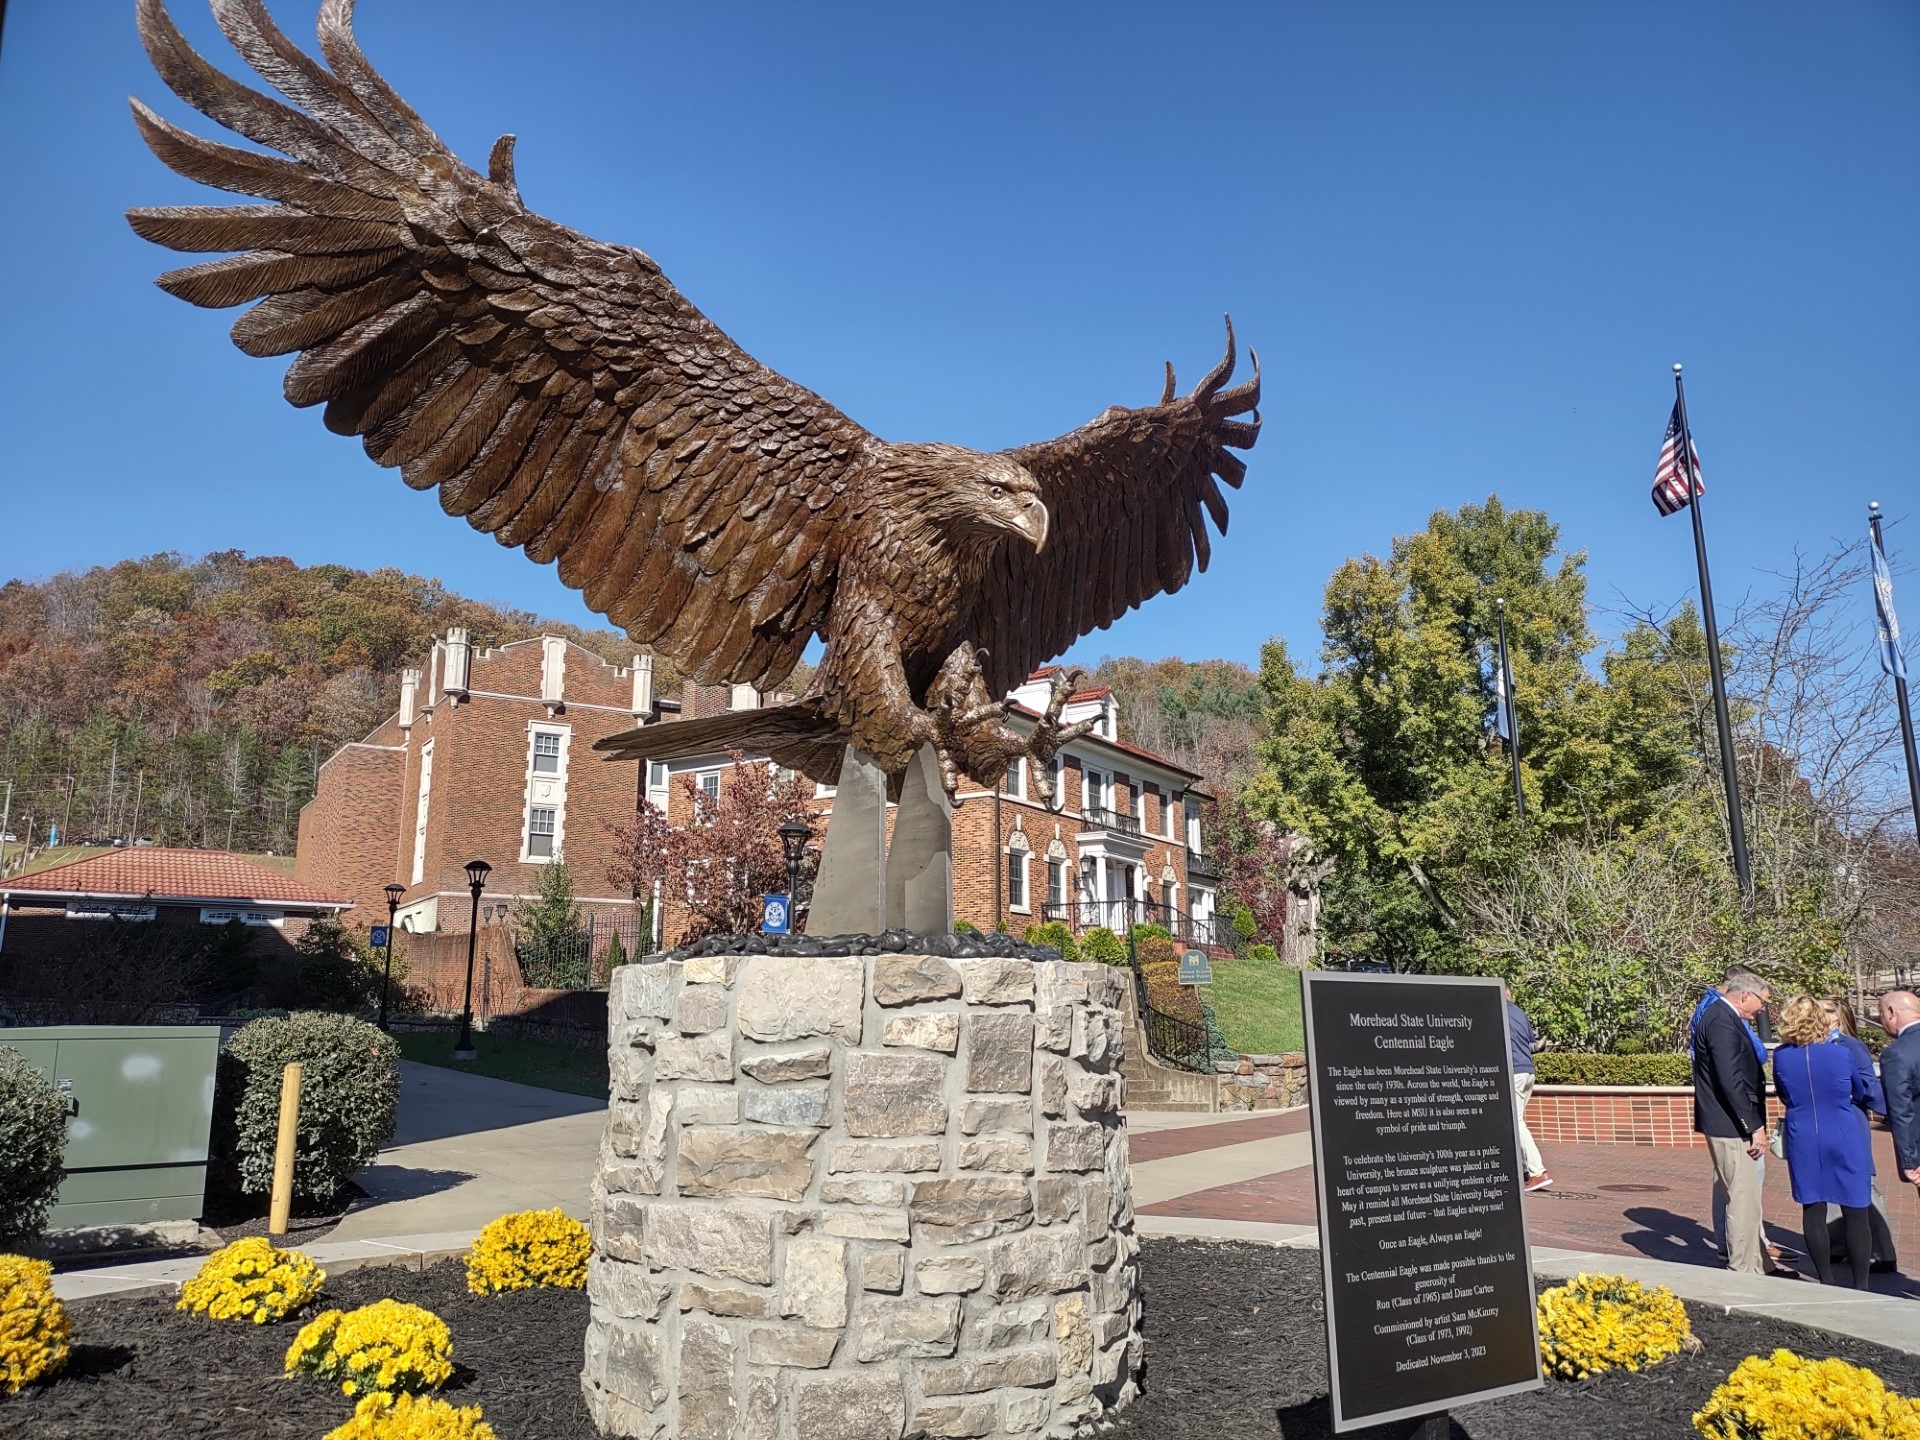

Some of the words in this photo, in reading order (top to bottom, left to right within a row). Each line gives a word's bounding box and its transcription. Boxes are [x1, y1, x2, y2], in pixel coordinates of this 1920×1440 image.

[1350, 1013, 1398, 1027] Morehead
[1401, 1014, 1424, 1027] State
[1426, 1015, 1472, 1030] University
[1375, 1036, 1426, 1049] Centennial
[1429, 1037, 1454, 1052] Eagle
[1328, 1067, 1341, 1077] The
[1343, 1067, 1362, 1078] Eagle
[1364, 1067, 1375, 1076] has
[1376, 1066, 1392, 1075] been
[1394, 1066, 1424, 1075] Morehead
[1426, 1066, 1441, 1075] State
[1479, 1065, 1499, 1073] mascot
[1336, 1082, 1353, 1090] since
[1355, 1081, 1365, 1090] the
[1367, 1081, 1383, 1092] early
[1407, 1080, 1428, 1089] Across
[1430, 1080, 1440, 1088] the
[1461, 1079, 1471, 1087] the
[1472, 1079, 1488, 1088] Eagle
[1489, 1078, 1495, 1086] is
[1334, 1097, 1357, 1106] viewed
[1359, 1096, 1368, 1107] by
[1370, 1097, 1388, 1107] many
[1404, 1094, 1427, 1105] symbol
[1428, 1094, 1435, 1103] of
[1464, 1092, 1487, 1102] courage
[1489, 1091, 1498, 1100] and
[1355, 1110, 1385, 1120] freedom.
[1387, 1109, 1402, 1118] Here
[1404, 1110, 1410, 1118] at
[1412, 1108, 1427, 1118] MSU
[1429, 1108, 1434, 1117] it
[1436, 1107, 1441, 1116] is
[1442, 1107, 1454, 1116] also
[1456, 1107, 1469, 1115] seen
[1376, 1123, 1400, 1135] symbol
[1402, 1123, 1409, 1133] of
[1411, 1122, 1426, 1134] pride
[1428, 1122, 1439, 1131] and
[1343, 1155, 1352, 1165] To
[1354, 1154, 1383, 1164] celebrate
[1385, 1153, 1395, 1163] the
[1455, 1150, 1468, 1159] year
[1469, 1149, 1475, 1157] as
[1483, 1146, 1500, 1158] public
[1347, 1169, 1383, 1181] University,
[1384, 1168, 1395, 1177] the
[1396, 1167, 1418, 1176] bronze
[1419, 1165, 1448, 1176] sculpture
[1450, 1164, 1461, 1172] was
[1463, 1162, 1482, 1172] placed
[1483, 1161, 1489, 1170] in
[1491, 1160, 1499, 1169] the
[1337, 1186, 1355, 1197] heart
[1356, 1185, 1364, 1195] of
[1365, 1185, 1391, 1195] campus
[1392, 1183, 1399, 1192] to
[1401, 1182, 1418, 1191] serve
[1419, 1182, 1426, 1190] as
[1433, 1178, 1459, 1189] unifying
[1461, 1175, 1484, 1186] emblem
[1486, 1174, 1492, 1184] of
[1342, 1202, 1357, 1213] May
[1359, 1201, 1364, 1210] it
[1366, 1199, 1389, 1209] remind
[1391, 1197, 1399, 1207] all
[1401, 1195, 1432, 1206] Morehead
[1434, 1193, 1449, 1204] State
[1451, 1189, 1481, 1203] University
[1483, 1188, 1502, 1198] Eagles
[1350, 1217, 1366, 1228] past,
[1368, 1215, 1392, 1228] present
[1393, 1212, 1405, 1222] and
[1407, 1211, 1426, 1221] future
[1434, 1208, 1445, 1218] that
[1447, 1206, 1467, 1217] Eagles
[1469, 1203, 1489, 1215] always
[1379, 1239, 1397, 1250] Once
[1429, 1233, 1453, 1245] Always
[1455, 1233, 1462, 1241] an
[1464, 1229, 1482, 1240] Eagle!
[1346, 1273, 1360, 1284] The
[1361, 1267, 1398, 1281] Centennial
[1400, 1266, 1418, 1277] Eagle
[1420, 1265, 1432, 1273] was
[1433, 1262, 1450, 1271] made
[1452, 1257, 1476, 1271] possible
[1477, 1254, 1497, 1264] thanks
[1498, 1254, 1504, 1262] to
[1506, 1252, 1515, 1261] the
[1415, 1276, 1447, 1291] generosity
[1449, 1274, 1455, 1284] of
[1376, 1300, 1390, 1310] Ron
[1392, 1297, 1412, 1309] (Class
[1414, 1295, 1421, 1304] of
[1423, 1291, 1440, 1304] 1965)
[1442, 1290, 1453, 1300] and
[1454, 1288, 1473, 1299] Diane
[1475, 1285, 1494, 1295] Cartee
[1374, 1317, 1423, 1335] Commissioned
[1424, 1316, 1433, 1329] by
[1434, 1314, 1450, 1325] artist
[1452, 1312, 1466, 1322] Sam
[1468, 1306, 1498, 1320] McKinney
[1406, 1335, 1426, 1347] (Class
[1428, 1332, 1435, 1342] of
[1396, 1359, 1428, 1372] Dedicated
[1430, 1352, 1462, 1364] November
[1464, 1350, 1470, 1361] 3,
[1472, 1346, 1486, 1356] 2023
